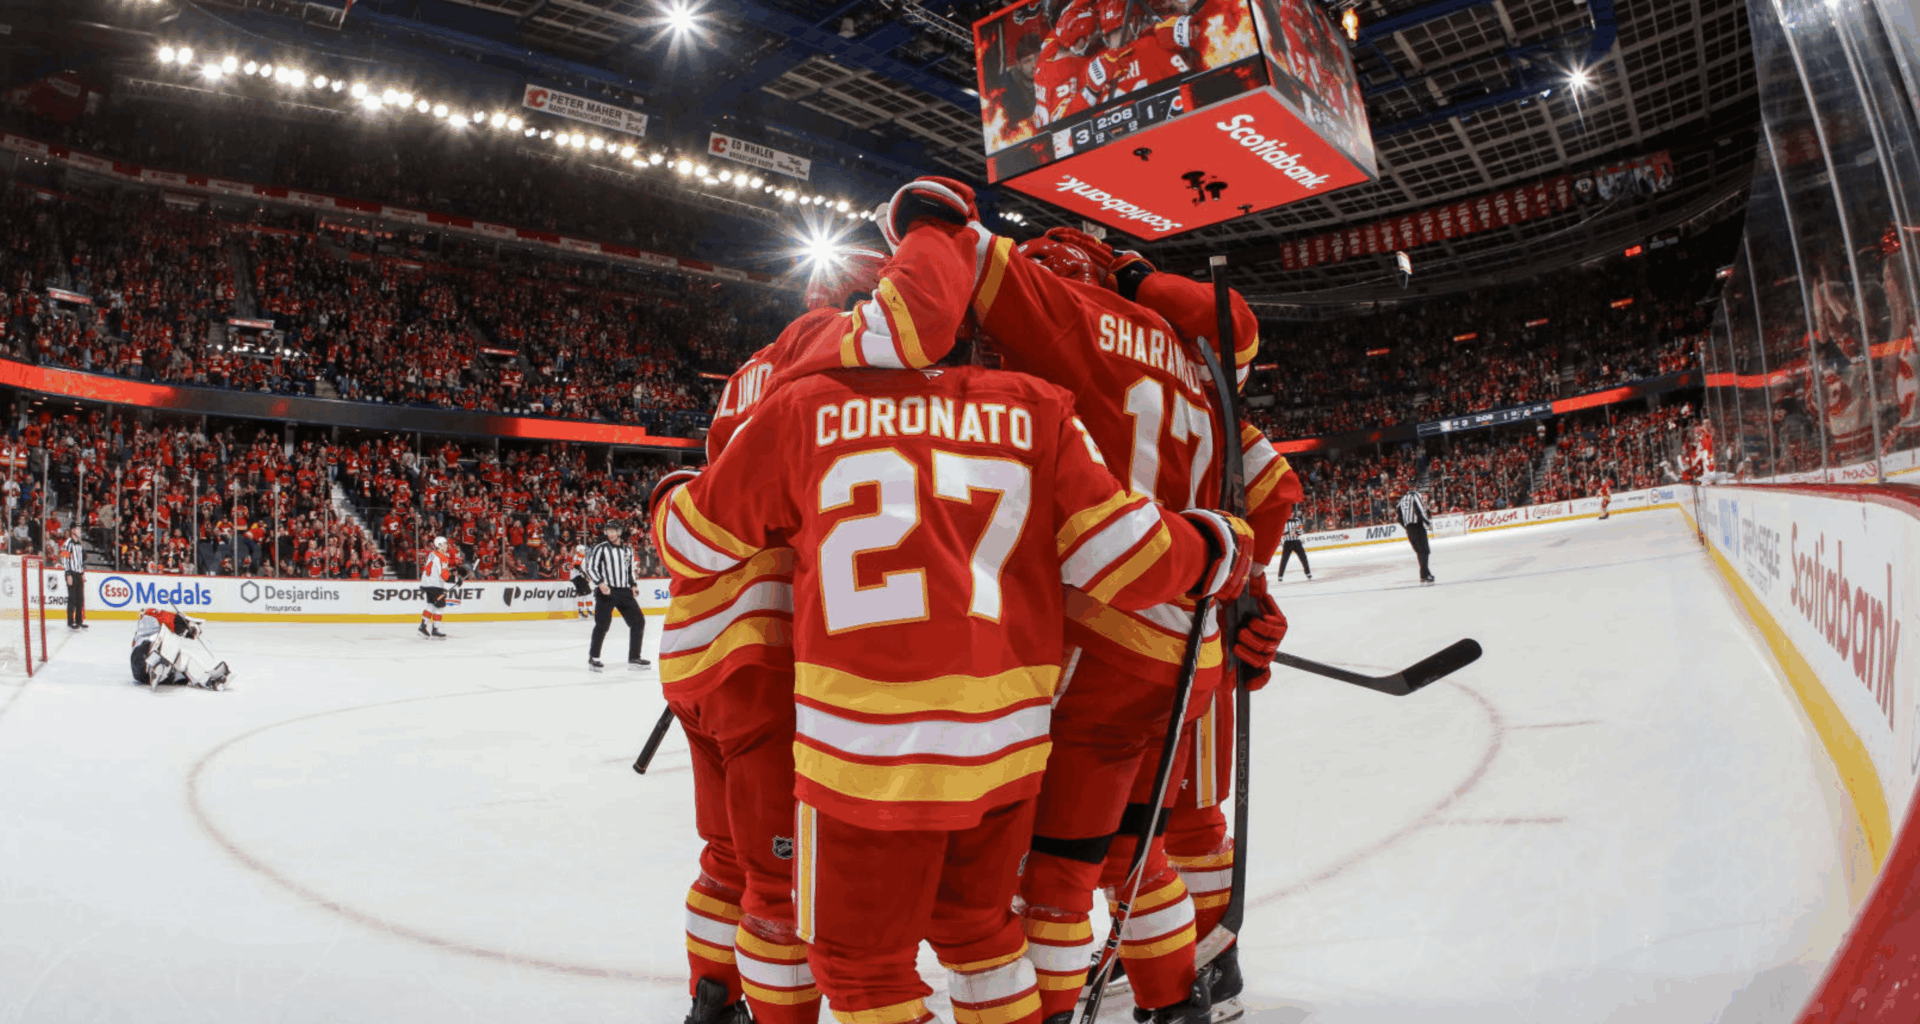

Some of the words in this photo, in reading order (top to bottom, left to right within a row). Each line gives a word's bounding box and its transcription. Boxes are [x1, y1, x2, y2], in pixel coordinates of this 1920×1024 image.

[550, 93, 584, 110] PETER
[586, 102, 622, 119] MAHER
[1096, 108, 1133, 130] 2:08
[1075, 129, 1090, 145] 3
[731, 139, 742, 150] ED
[744, 143, 775, 160] WHALEN
[1217, 114, 1330, 190] Scotiabank
[1055, 174, 1183, 232] Scotiabank
[816, 395, 1033, 451] CORONATO
[1123, 374, 1213, 510] 17
[1464, 510, 1519, 529] Molson
[818, 446, 1033, 637] 27
[1366, 525, 1397, 540] MNP
[104, 583, 129, 598] Esso
[136, 582, 212, 606] Medals
[265, 585, 340, 603] Desjardins
[524, 586, 556, 601] play
[265, 604, 303, 612] Insurance
[1790, 520, 1900, 734] Scotiabank
